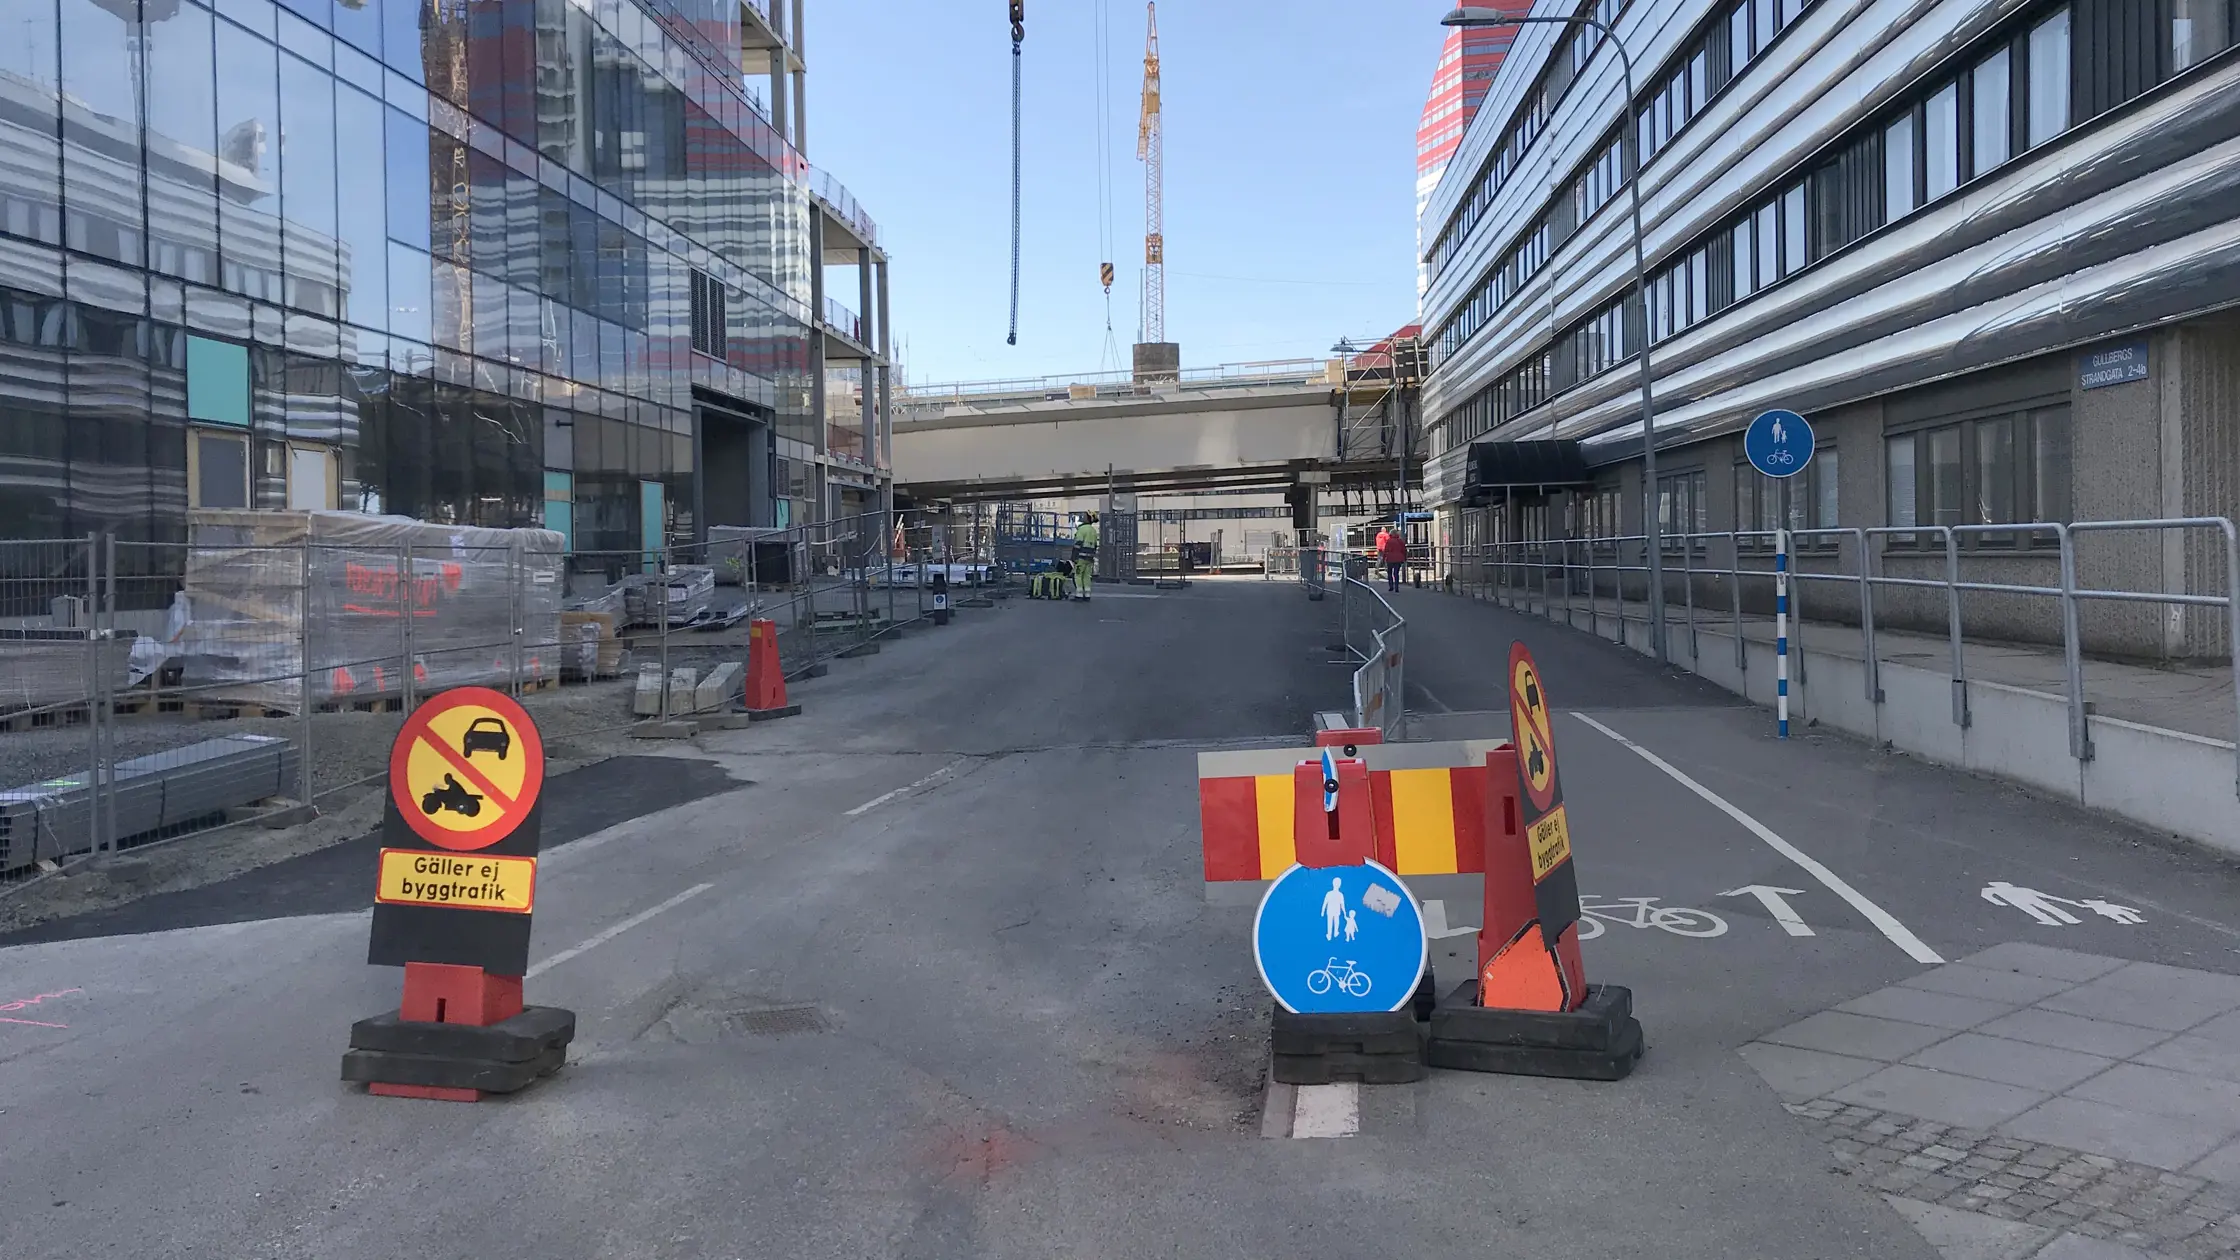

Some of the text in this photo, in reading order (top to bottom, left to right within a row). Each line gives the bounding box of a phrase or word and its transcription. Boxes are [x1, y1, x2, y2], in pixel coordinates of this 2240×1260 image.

[2081, 367, 2124, 386] STRANDGATA
[1536, 812, 1561, 844] Gäller ej
[1537, 834, 1566, 870] byggtrafik
[414, 856, 500, 882] Gäller ej
[401, 877, 507, 902] byggtrafik
